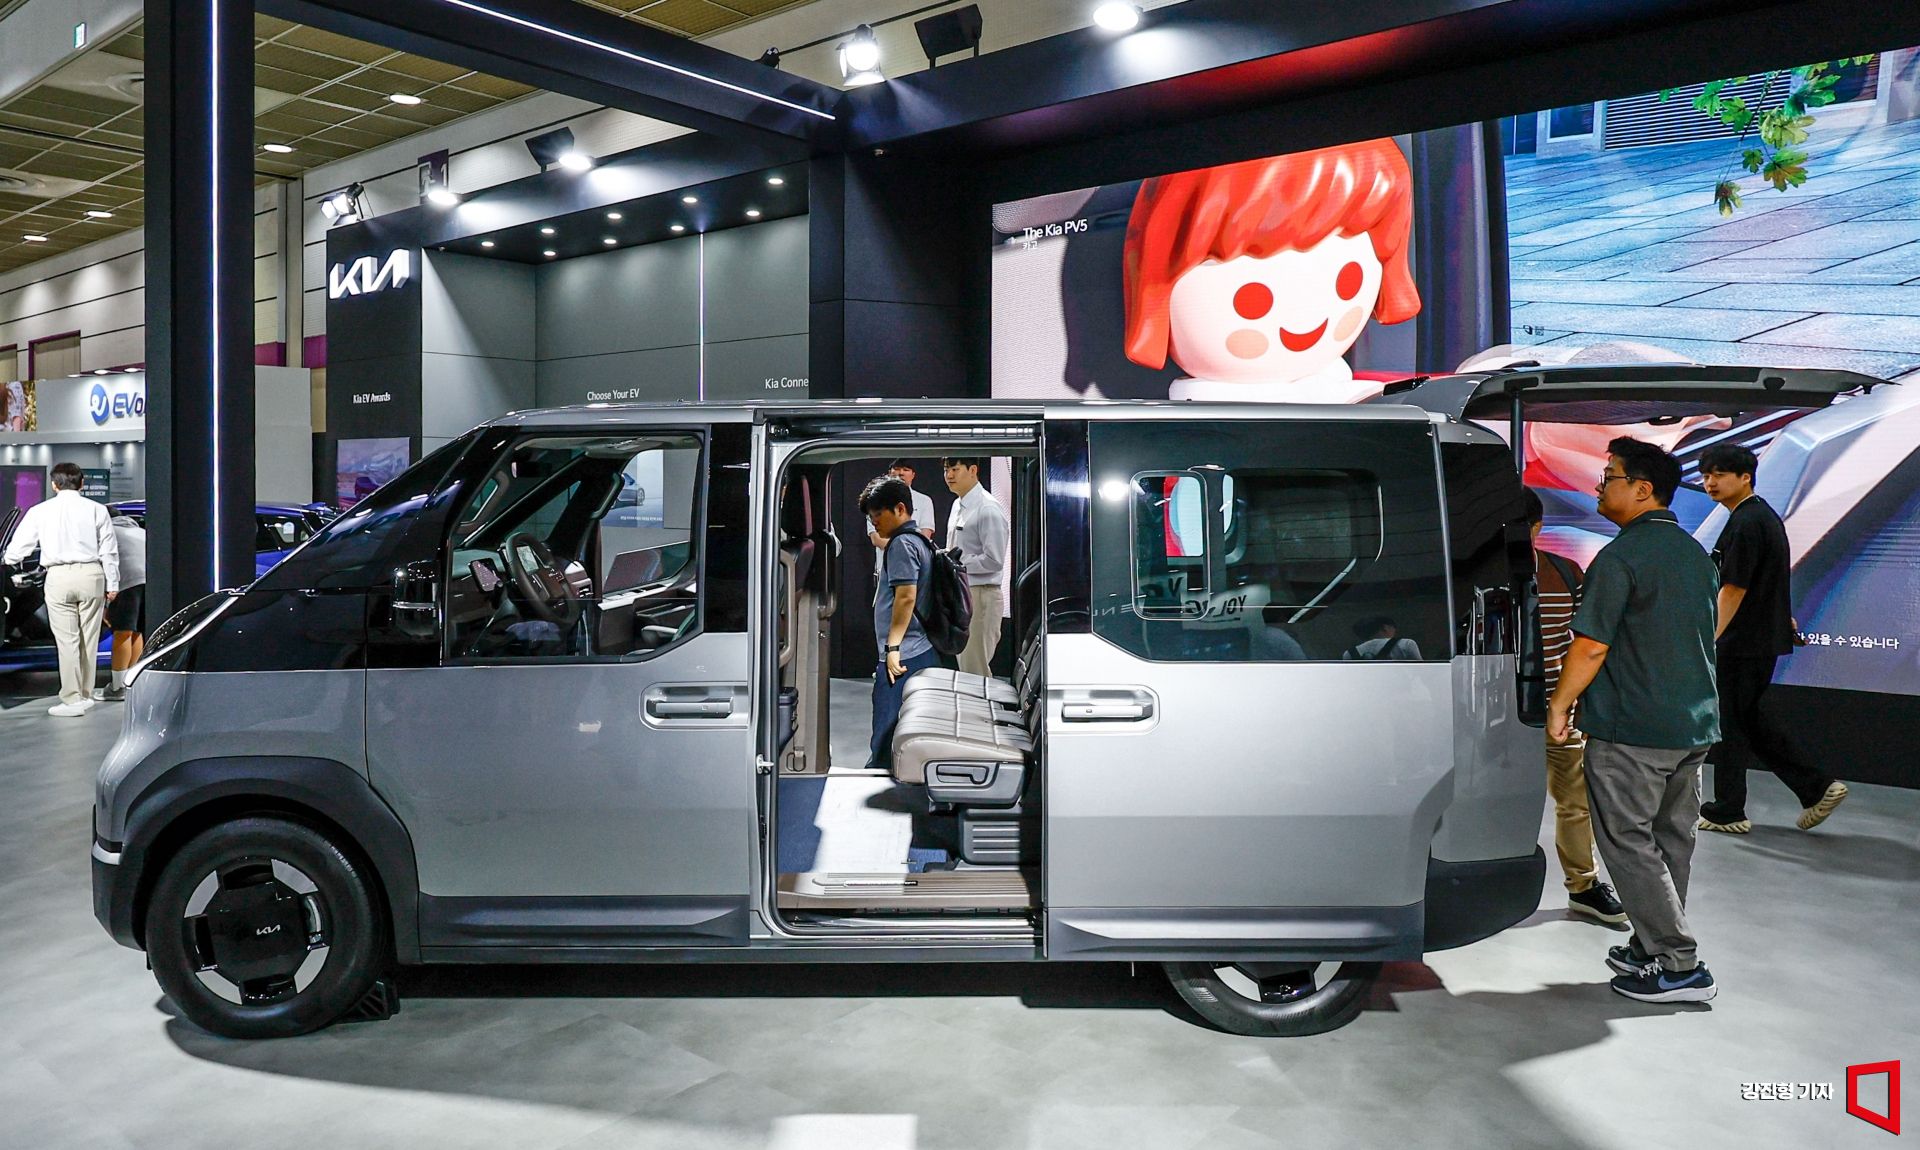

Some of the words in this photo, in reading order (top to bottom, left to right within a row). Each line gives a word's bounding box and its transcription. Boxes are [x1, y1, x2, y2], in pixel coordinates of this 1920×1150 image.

[1022, 226, 1044, 240] The
[1045, 223, 1063, 237] Kia
[1064, 219, 1089, 234] PV5
[329, 248, 410, 300] KIA
[765, 378, 779, 389] Kia
[780, 377, 809, 388] Conne
[353, 394, 362, 404] Kia
[362, 393, 370, 403] EV
[370, 391, 391, 402] Awards
[587, 391, 611, 401] Choose
[612, 389, 629, 399] Your
[629, 387, 640, 399] EV
[112, 392, 145, 418] EVo
[1807, 633, 1832, 646] 있을
[1833, 634, 1848, 646] 수
[1849, 635, 1900, 650] 있습니다
[255, 924, 281, 936] KIA
